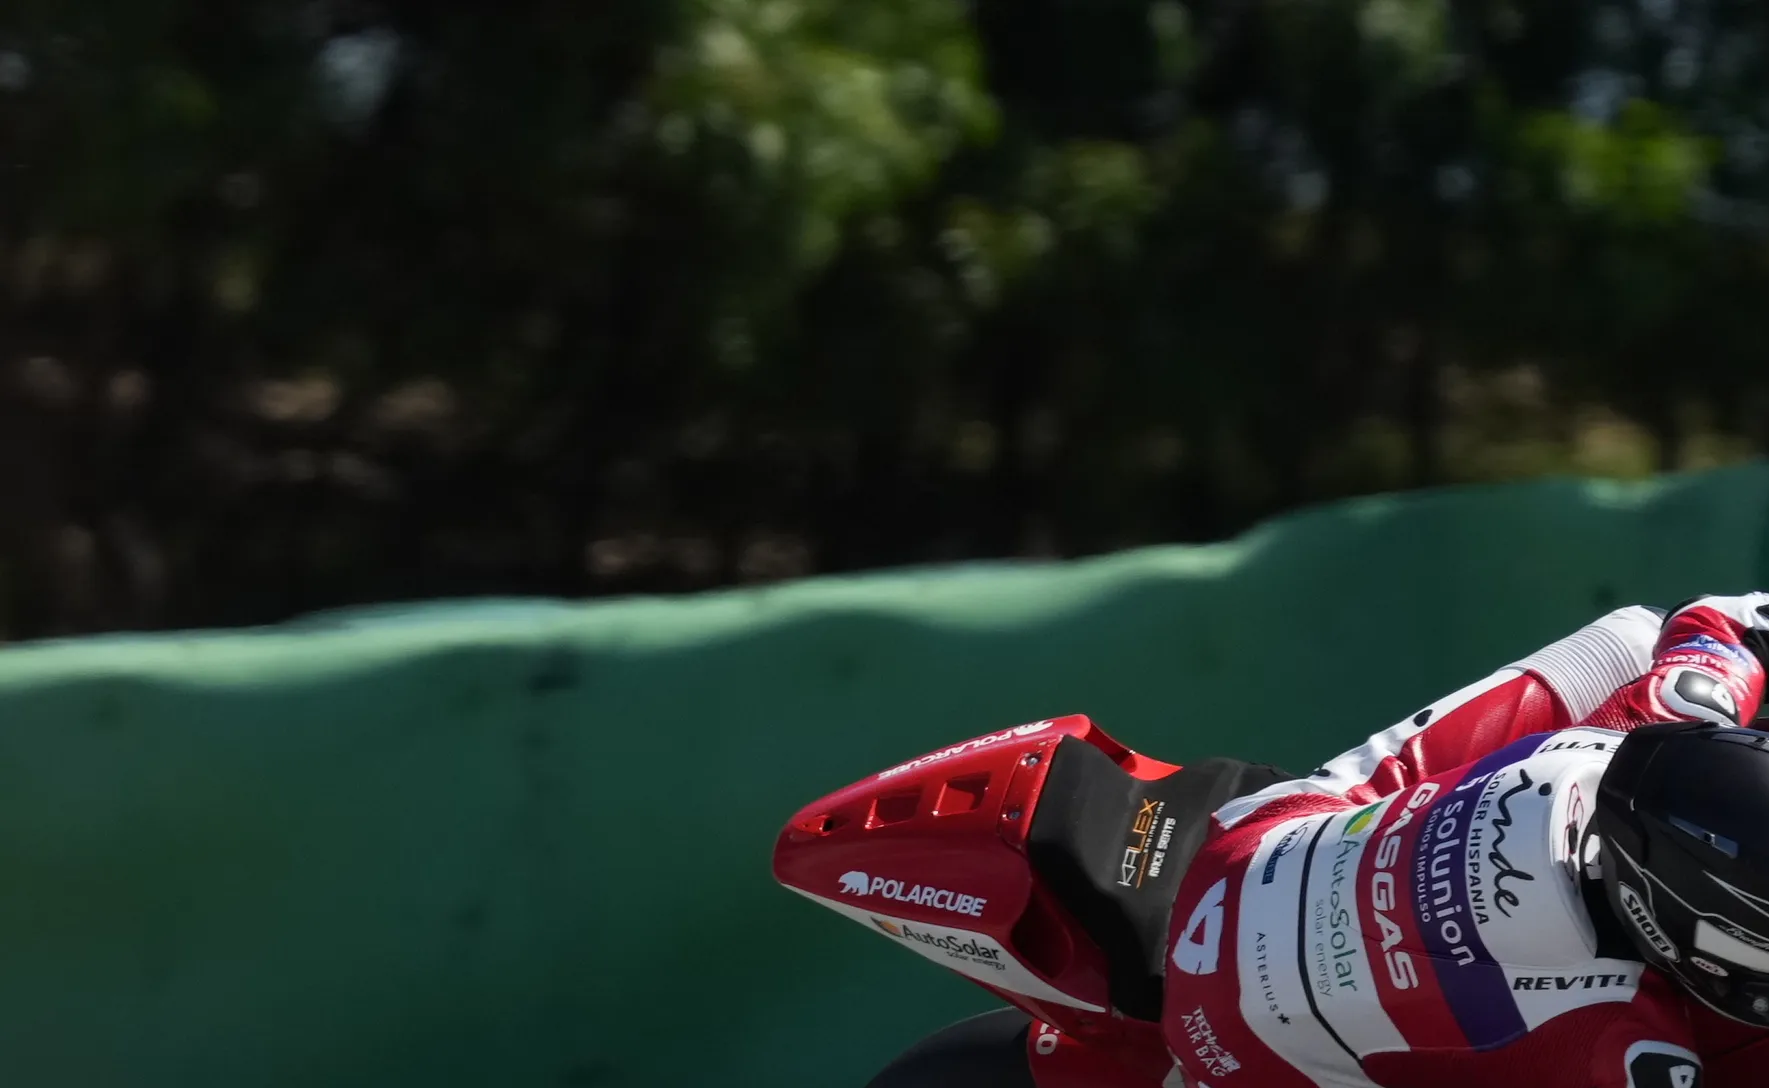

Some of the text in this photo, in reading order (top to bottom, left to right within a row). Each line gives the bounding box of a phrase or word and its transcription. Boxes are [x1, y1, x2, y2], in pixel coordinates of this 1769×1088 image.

[877, 728, 1014, 781] POLARCUBE
[1116, 798, 1159, 886] KALEX
[1148, 817, 1176, 877] RACE SEATS
[1413, 806, 1440, 924] SOMOS IMPULSO
[1430, 799, 1476, 967] solunion
[1465, 772, 1507, 926] SOLER HISPANIA
[868, 876, 987, 917] POLARCUBE
[1331, 839, 1358, 993] AutoSolar
[1371, 782, 1440, 990] GASGAS
[1623, 894, 1673, 953] SHOEI
[901, 924, 1000, 961] AutoSolar
[1256, 931, 1279, 1013] ASTERIUS
[1315, 898, 1333, 998] solar energy
[1513, 974, 1627, 991] REV'IT!
[1195, 1045, 1227, 1076] BAG
